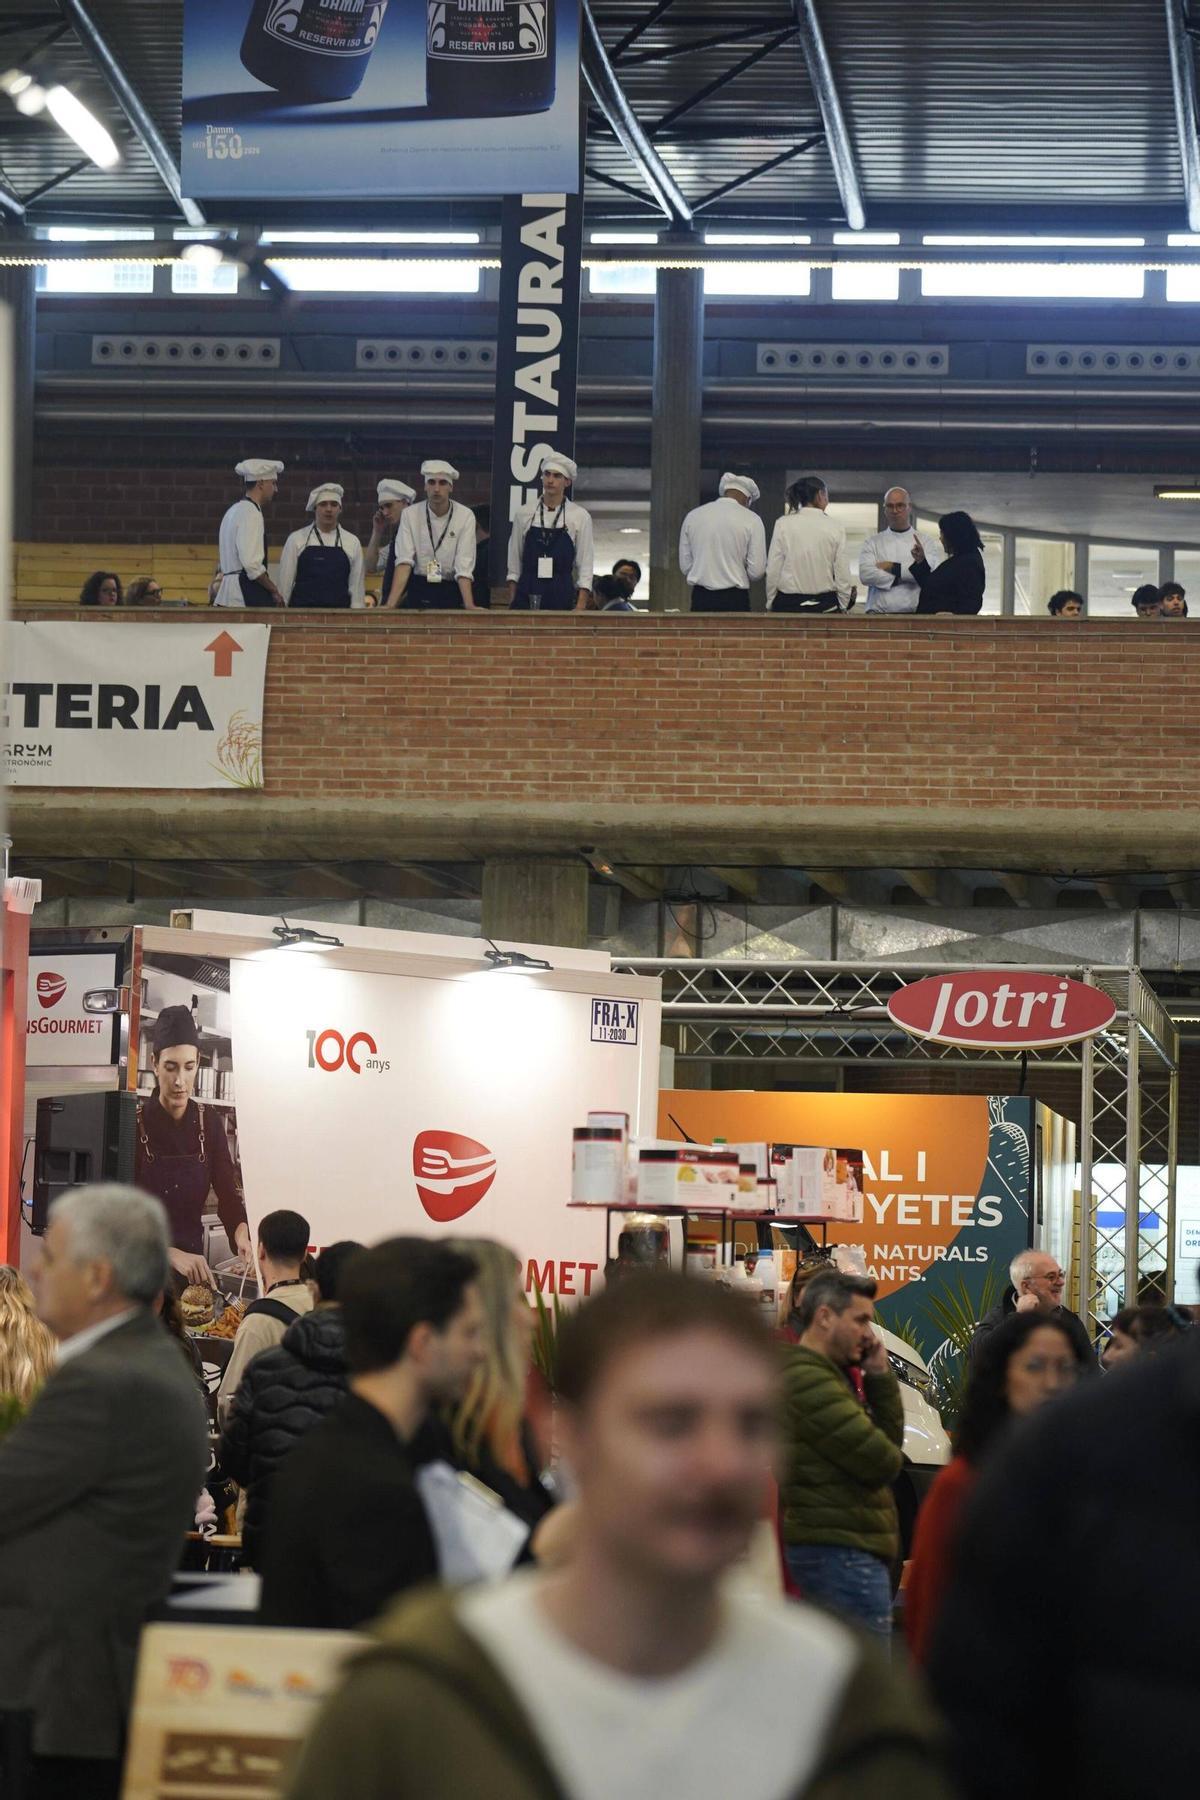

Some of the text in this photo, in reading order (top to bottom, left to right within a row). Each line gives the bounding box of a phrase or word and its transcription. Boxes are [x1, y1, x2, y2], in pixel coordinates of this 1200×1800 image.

[298, 29, 361, 47] RESERVA 150
[448, 40, 515, 51] RESERVA 150
[206, 124, 234, 134] Damm
[206, 134, 243, 159] 150
[594, 1002, 635, 1028] FRA-X
[924, 981, 1069, 1040] Jotri
[599, 1027, 627, 1040] 11-2030
[366, 1058, 391, 1073] anys
[917, 1151, 926, 1182] I
[873, 1244, 989, 1262] NATURALS
